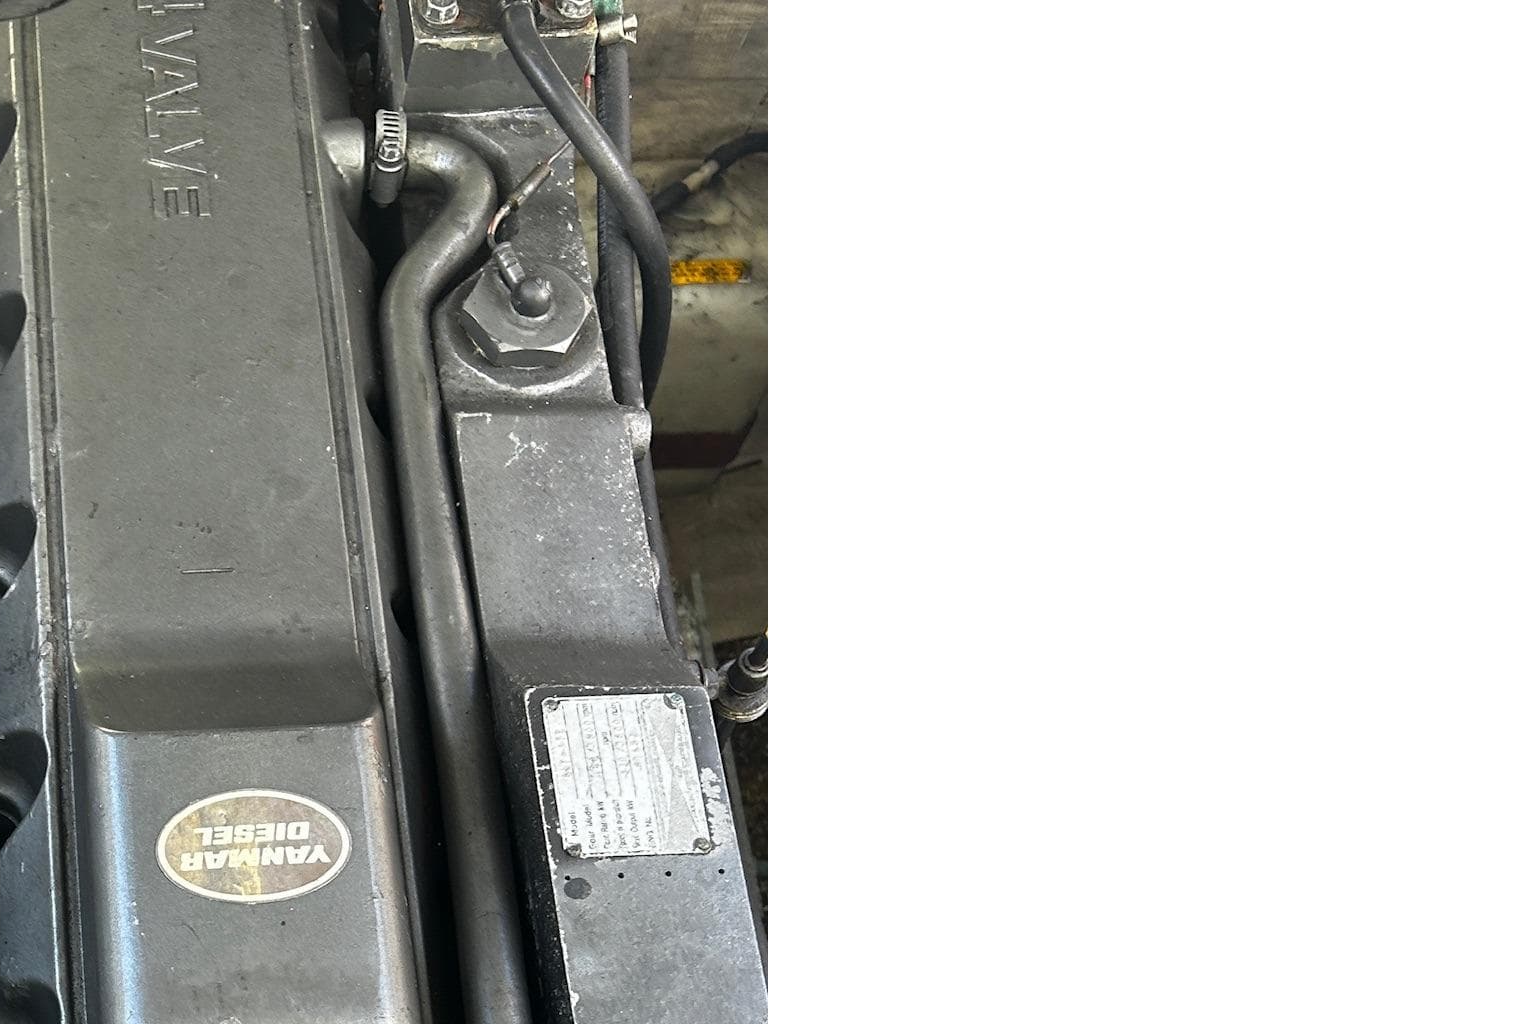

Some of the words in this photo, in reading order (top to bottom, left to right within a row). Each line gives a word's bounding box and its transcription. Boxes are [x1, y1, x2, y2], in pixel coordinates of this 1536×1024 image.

[137, 27, 212, 219] VALVE
[194, 821, 311, 846] DIESEL
[180, 844, 331, 872] YANMAR
